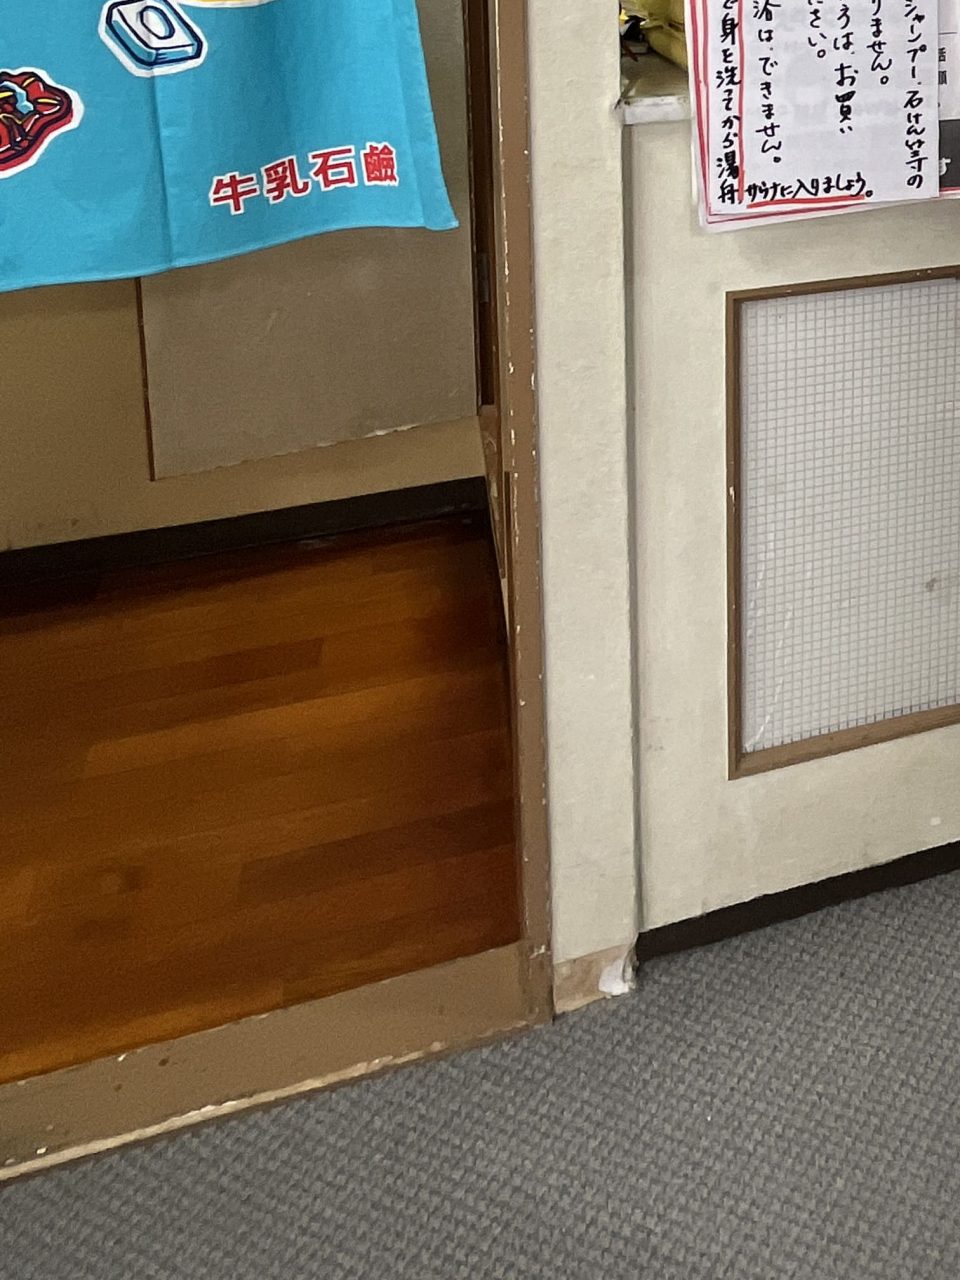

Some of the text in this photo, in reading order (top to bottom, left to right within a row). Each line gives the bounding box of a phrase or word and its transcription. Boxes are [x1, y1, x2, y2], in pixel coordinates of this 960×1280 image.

[745, 171, 874, 203] サウナに入りましょう。
